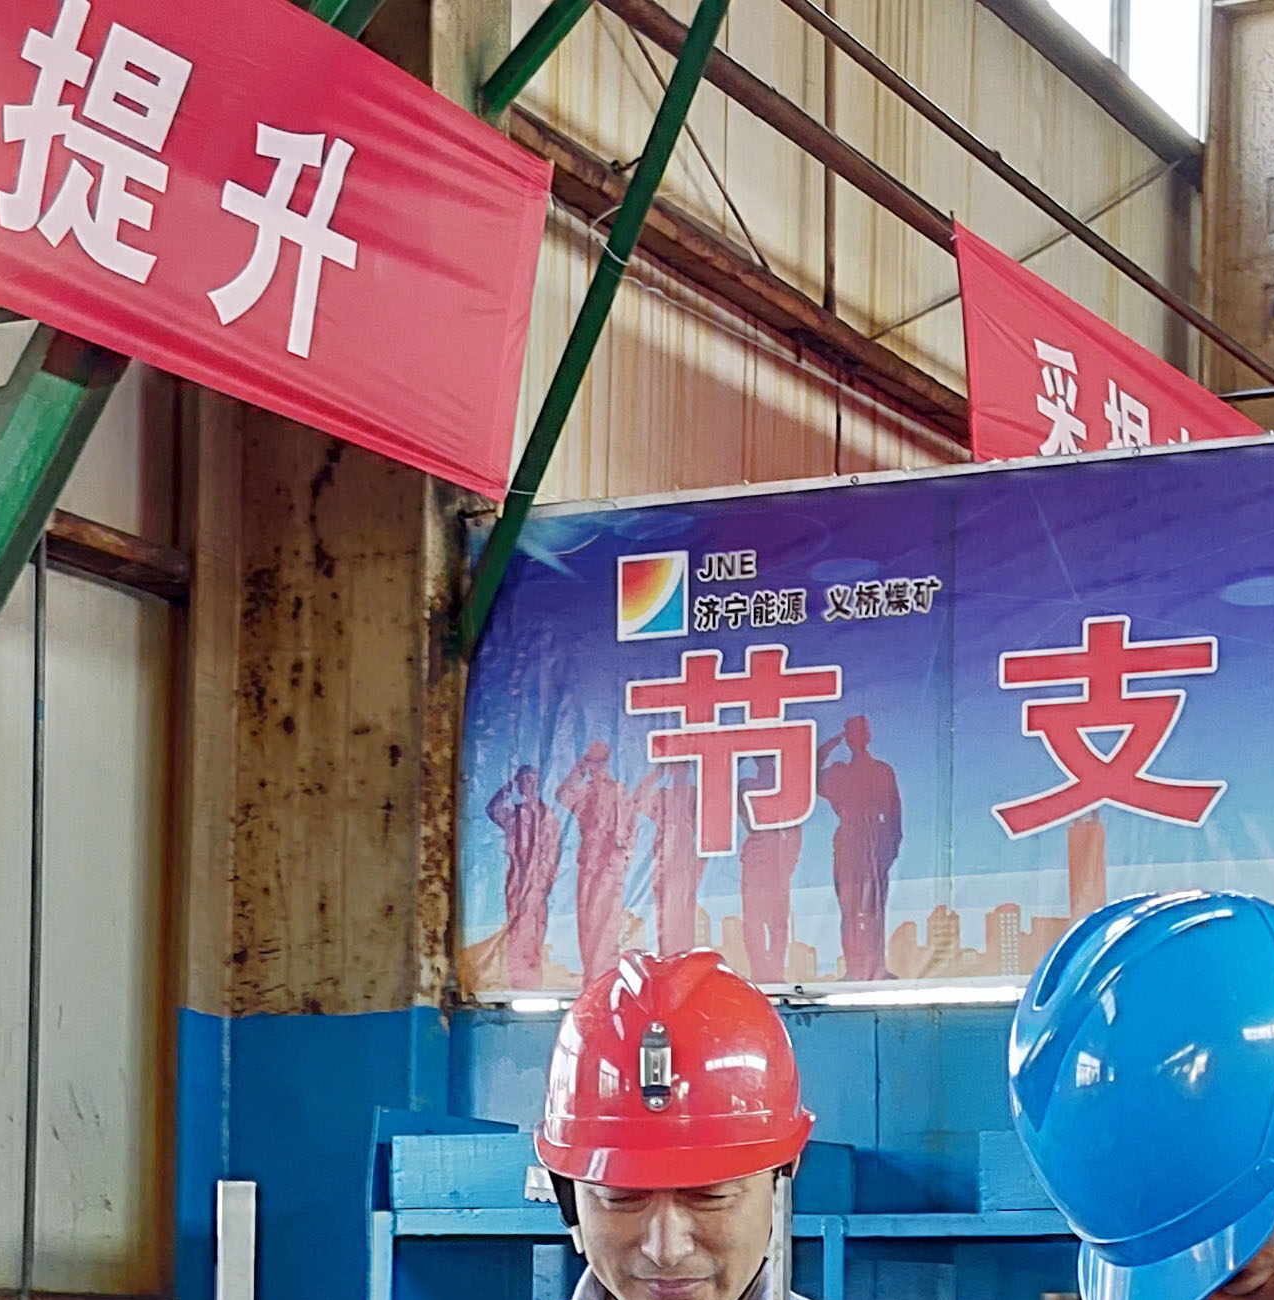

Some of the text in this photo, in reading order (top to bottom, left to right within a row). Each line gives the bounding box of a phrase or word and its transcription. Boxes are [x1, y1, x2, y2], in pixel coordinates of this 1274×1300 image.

[696, 550, 757, 581] JNE
[695, 578, 941, 632] 济宁能源 义桥煤矿
